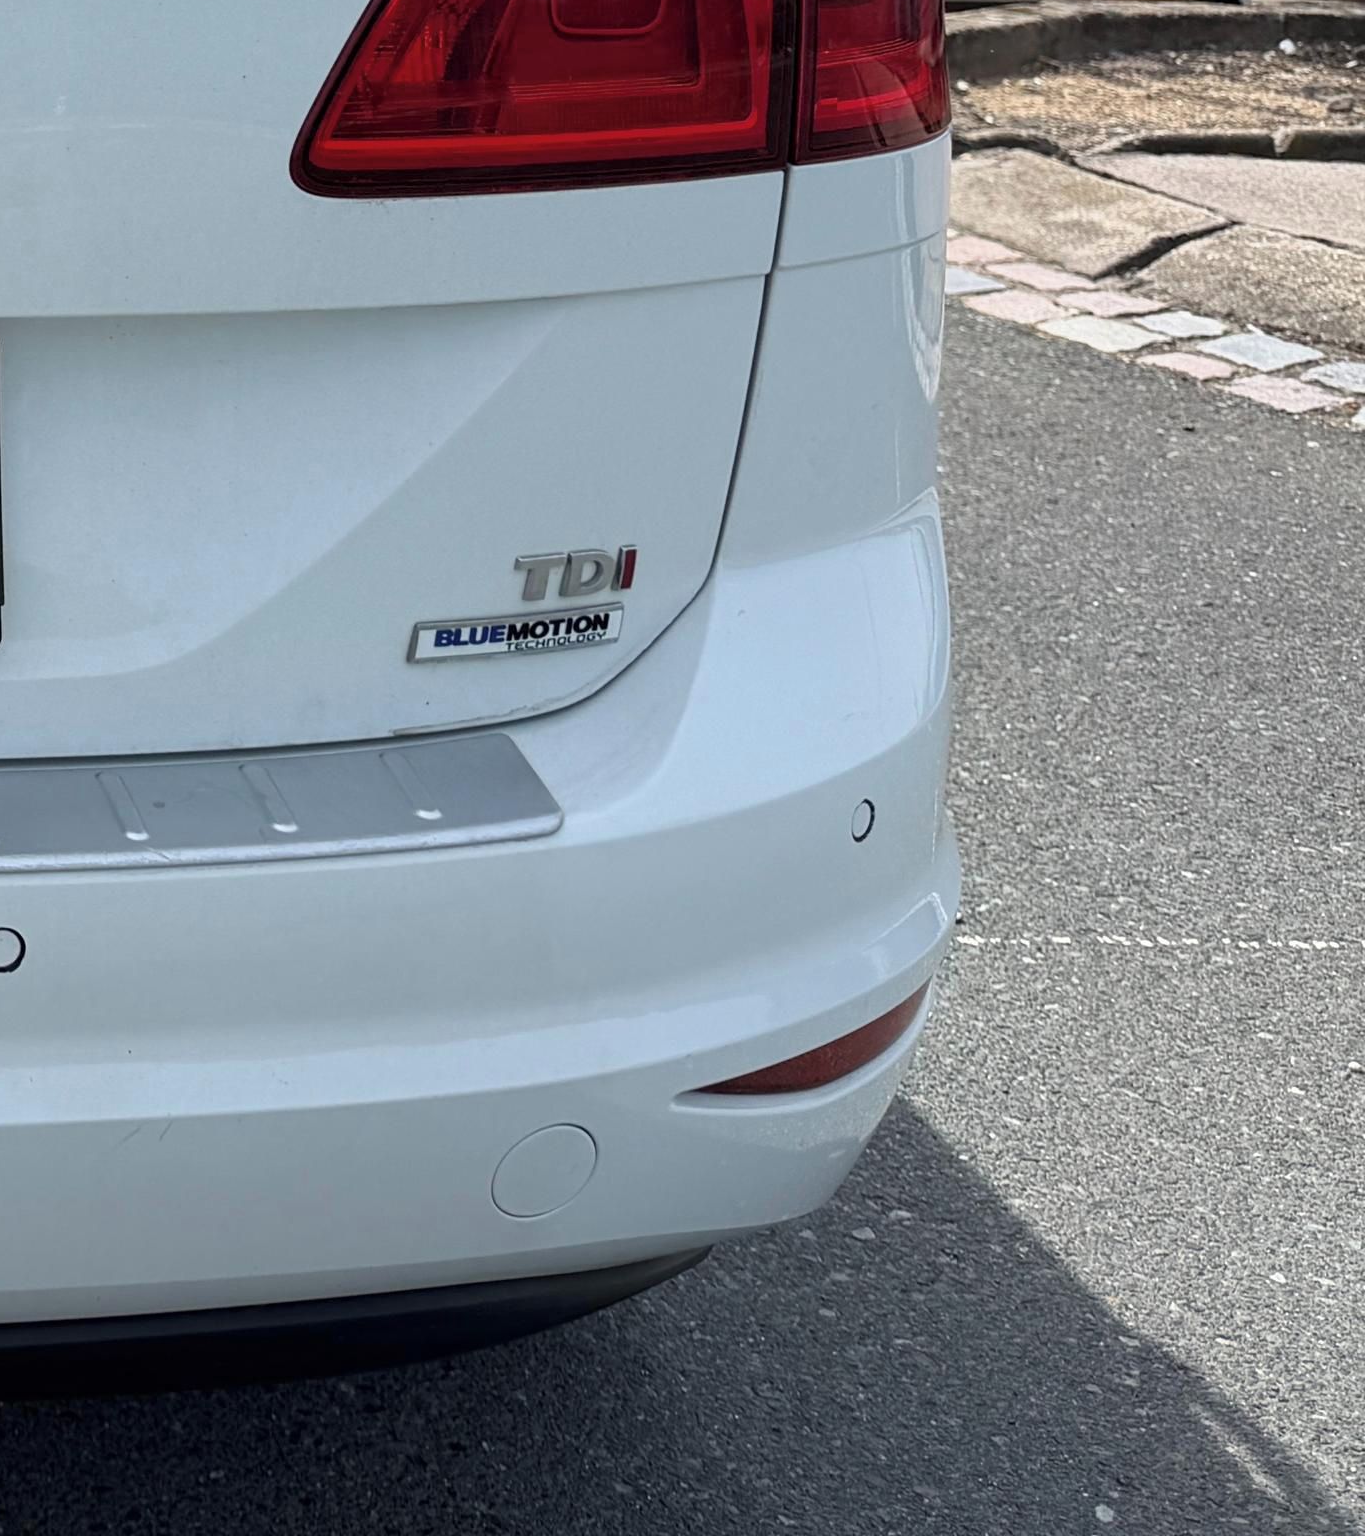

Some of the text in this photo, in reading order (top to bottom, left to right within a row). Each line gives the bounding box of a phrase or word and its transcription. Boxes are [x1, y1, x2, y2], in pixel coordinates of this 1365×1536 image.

[514, 543, 638, 602] TDI
[433, 612, 611, 648] BLUEMOTION
[505, 630, 607, 653] TECHNOLOGY
